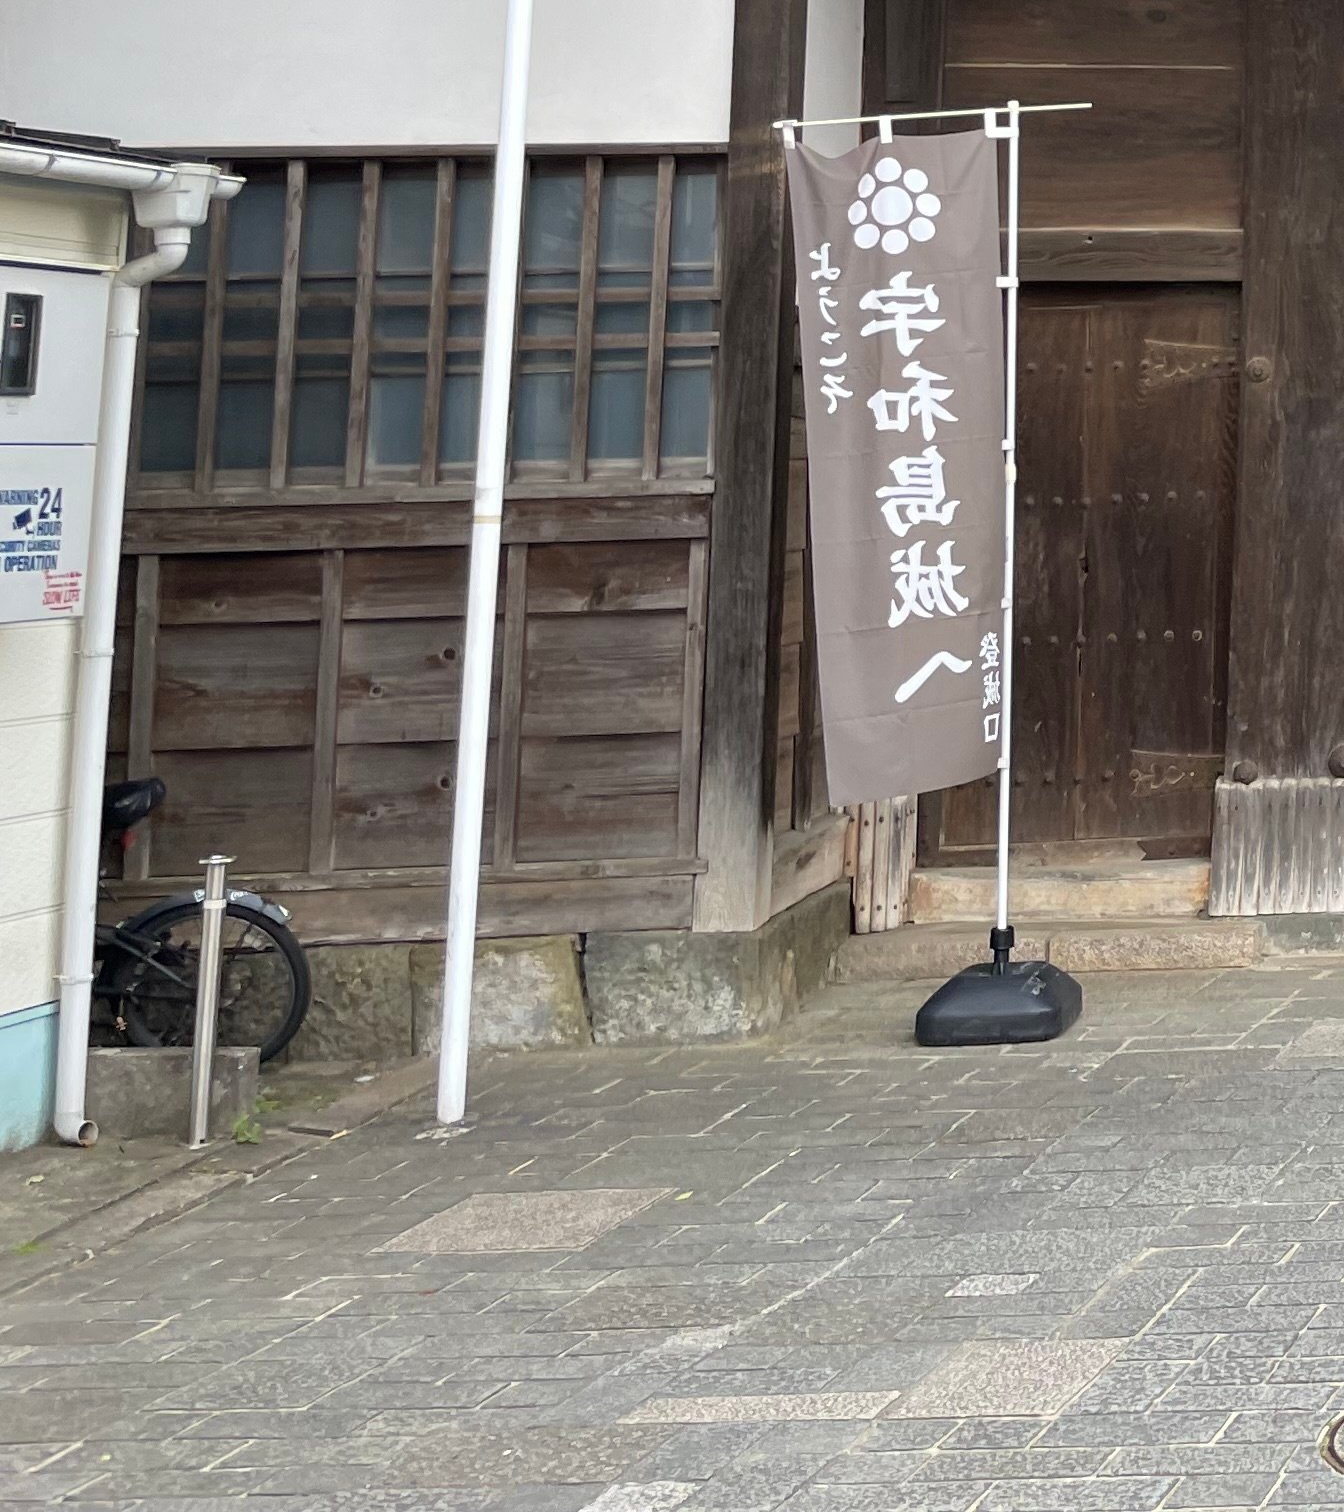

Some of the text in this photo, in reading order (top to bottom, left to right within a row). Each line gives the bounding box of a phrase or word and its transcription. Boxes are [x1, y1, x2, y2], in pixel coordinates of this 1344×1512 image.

[39, 487, 62, 519] 24
[37, 521, 62, 536] HOUR
[4, 555, 58, 572] OPERATION
